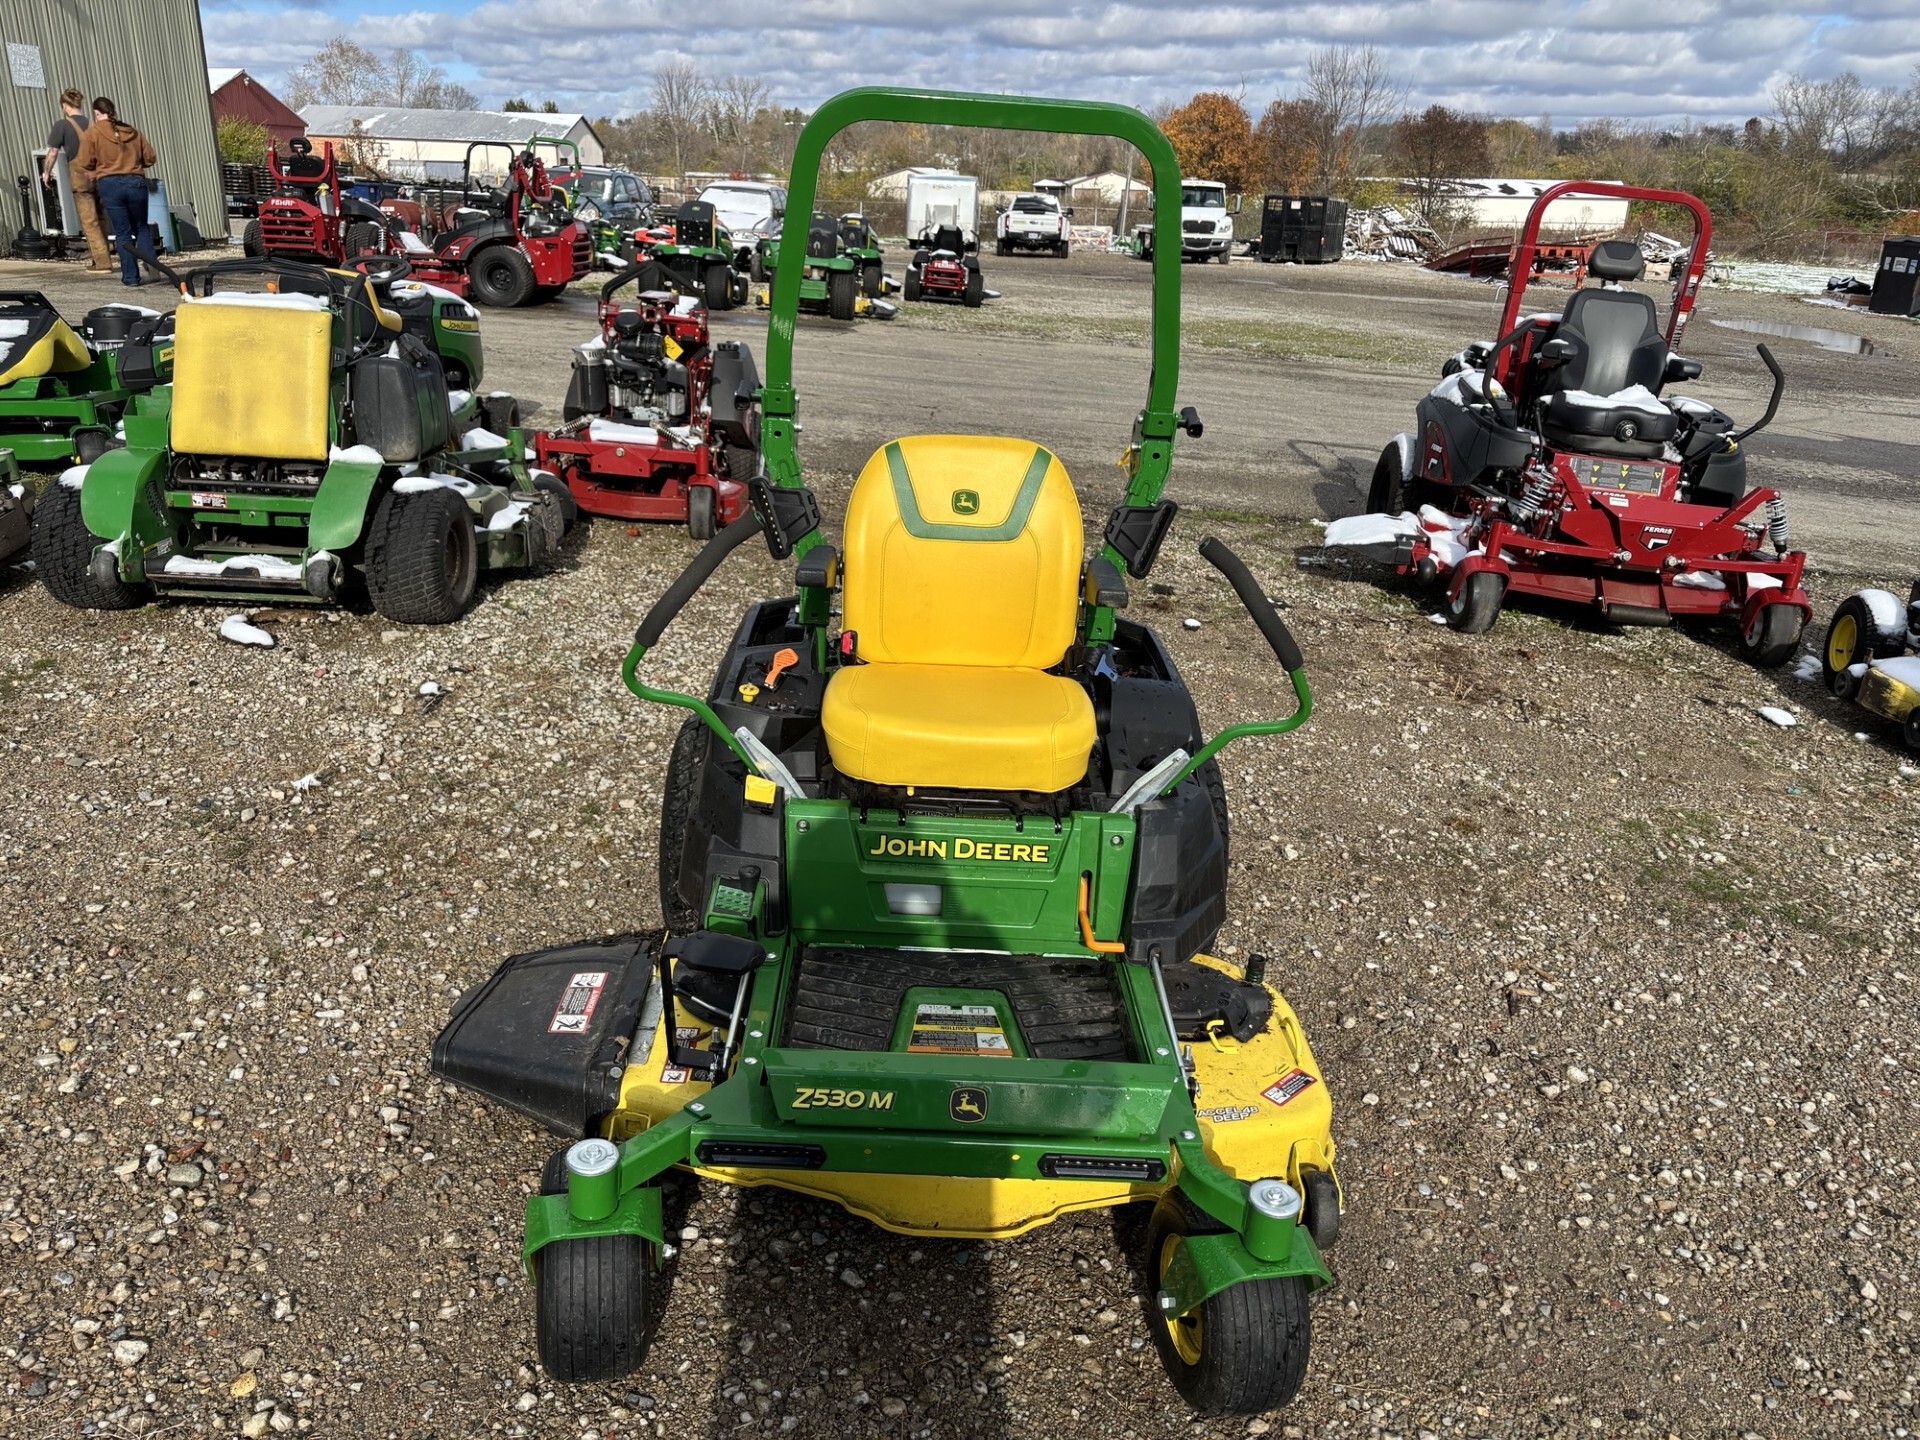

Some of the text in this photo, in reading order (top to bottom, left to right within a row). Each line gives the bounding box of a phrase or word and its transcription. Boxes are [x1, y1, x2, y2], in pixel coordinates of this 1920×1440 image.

[1644, 526, 1673, 535] FERRIS
[870, 834, 1050, 863] JOHN DEERE
[1198, 1105, 1259, 1118] ACCEL 48
[1212, 1112, 1251, 1123] DEEP
